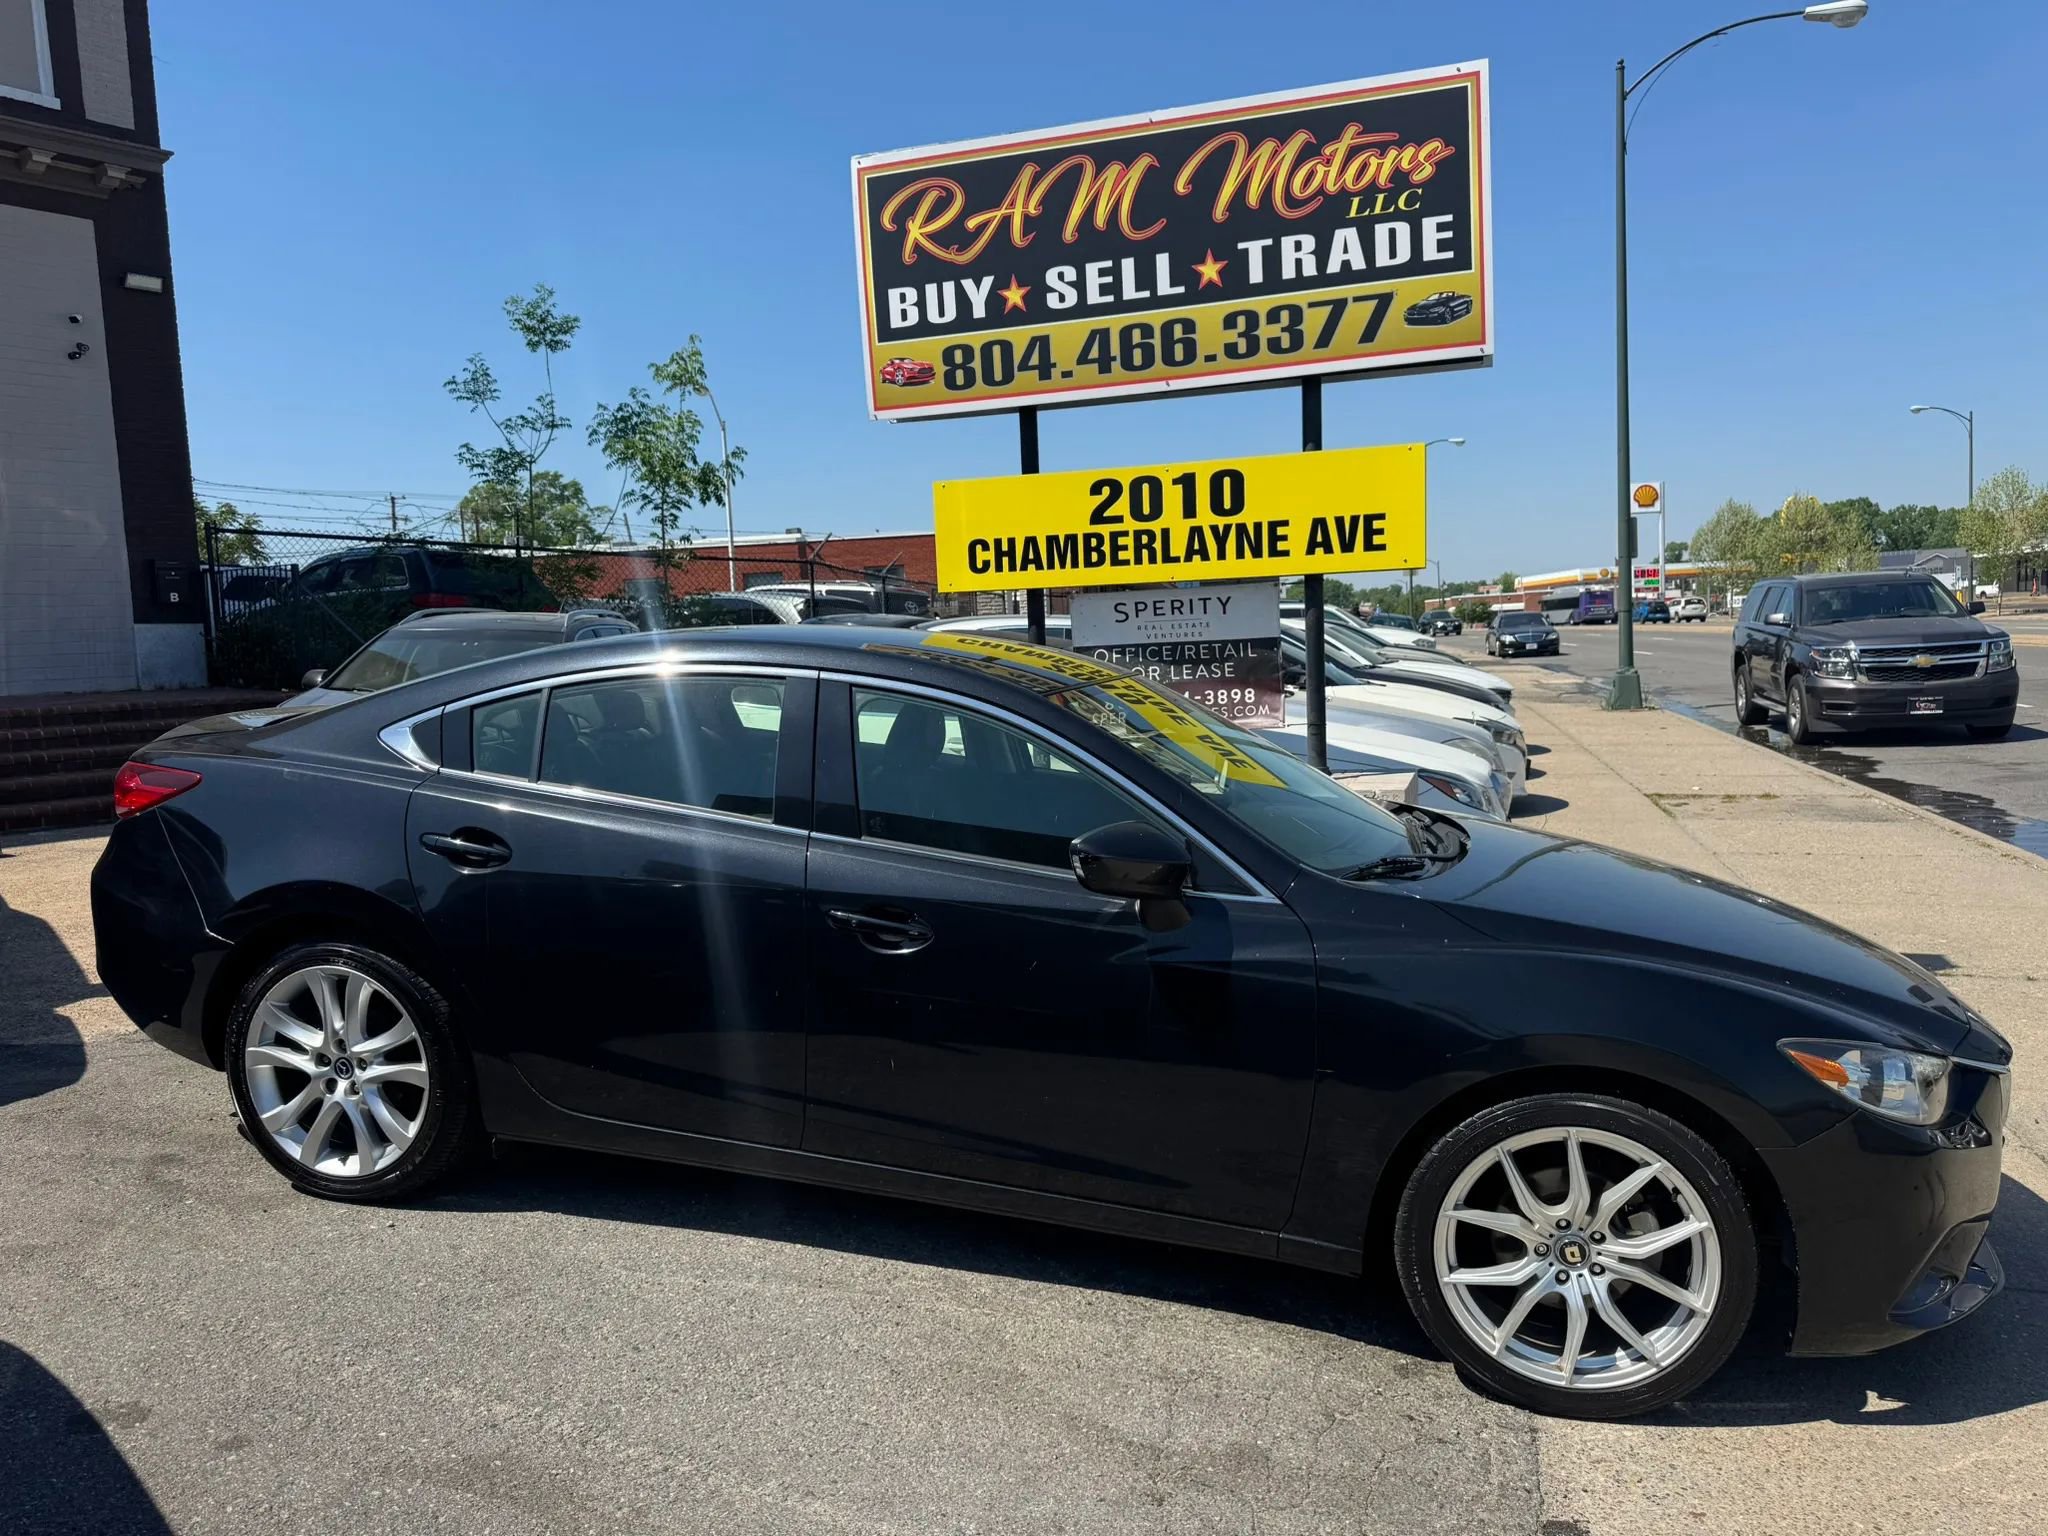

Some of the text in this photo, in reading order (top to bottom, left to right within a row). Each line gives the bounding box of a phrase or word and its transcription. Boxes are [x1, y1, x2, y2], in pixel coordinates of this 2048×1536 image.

[1174, 122, 1456, 223] Motors
[1345, 188, 1423, 218] LLC
[887, 214, 1454, 329] BUY SELL TRADE
[941, 291, 1397, 392] 804.466.3377
[1089, 468, 1246, 526] 2010
[967, 512, 1387, 574] CHAMBERLAYNE AVE
[170, 592, 179, 602] B
[1113, 595, 1232, 623] SPERITY
[1146, 631, 1203, 639] VENTURES
[1171, 621, 1211, 630] ESTATE
[1094, 642, 1258, 663] OFFICE/RETAIL
[1131, 662, 1235, 681] OR LEASE
